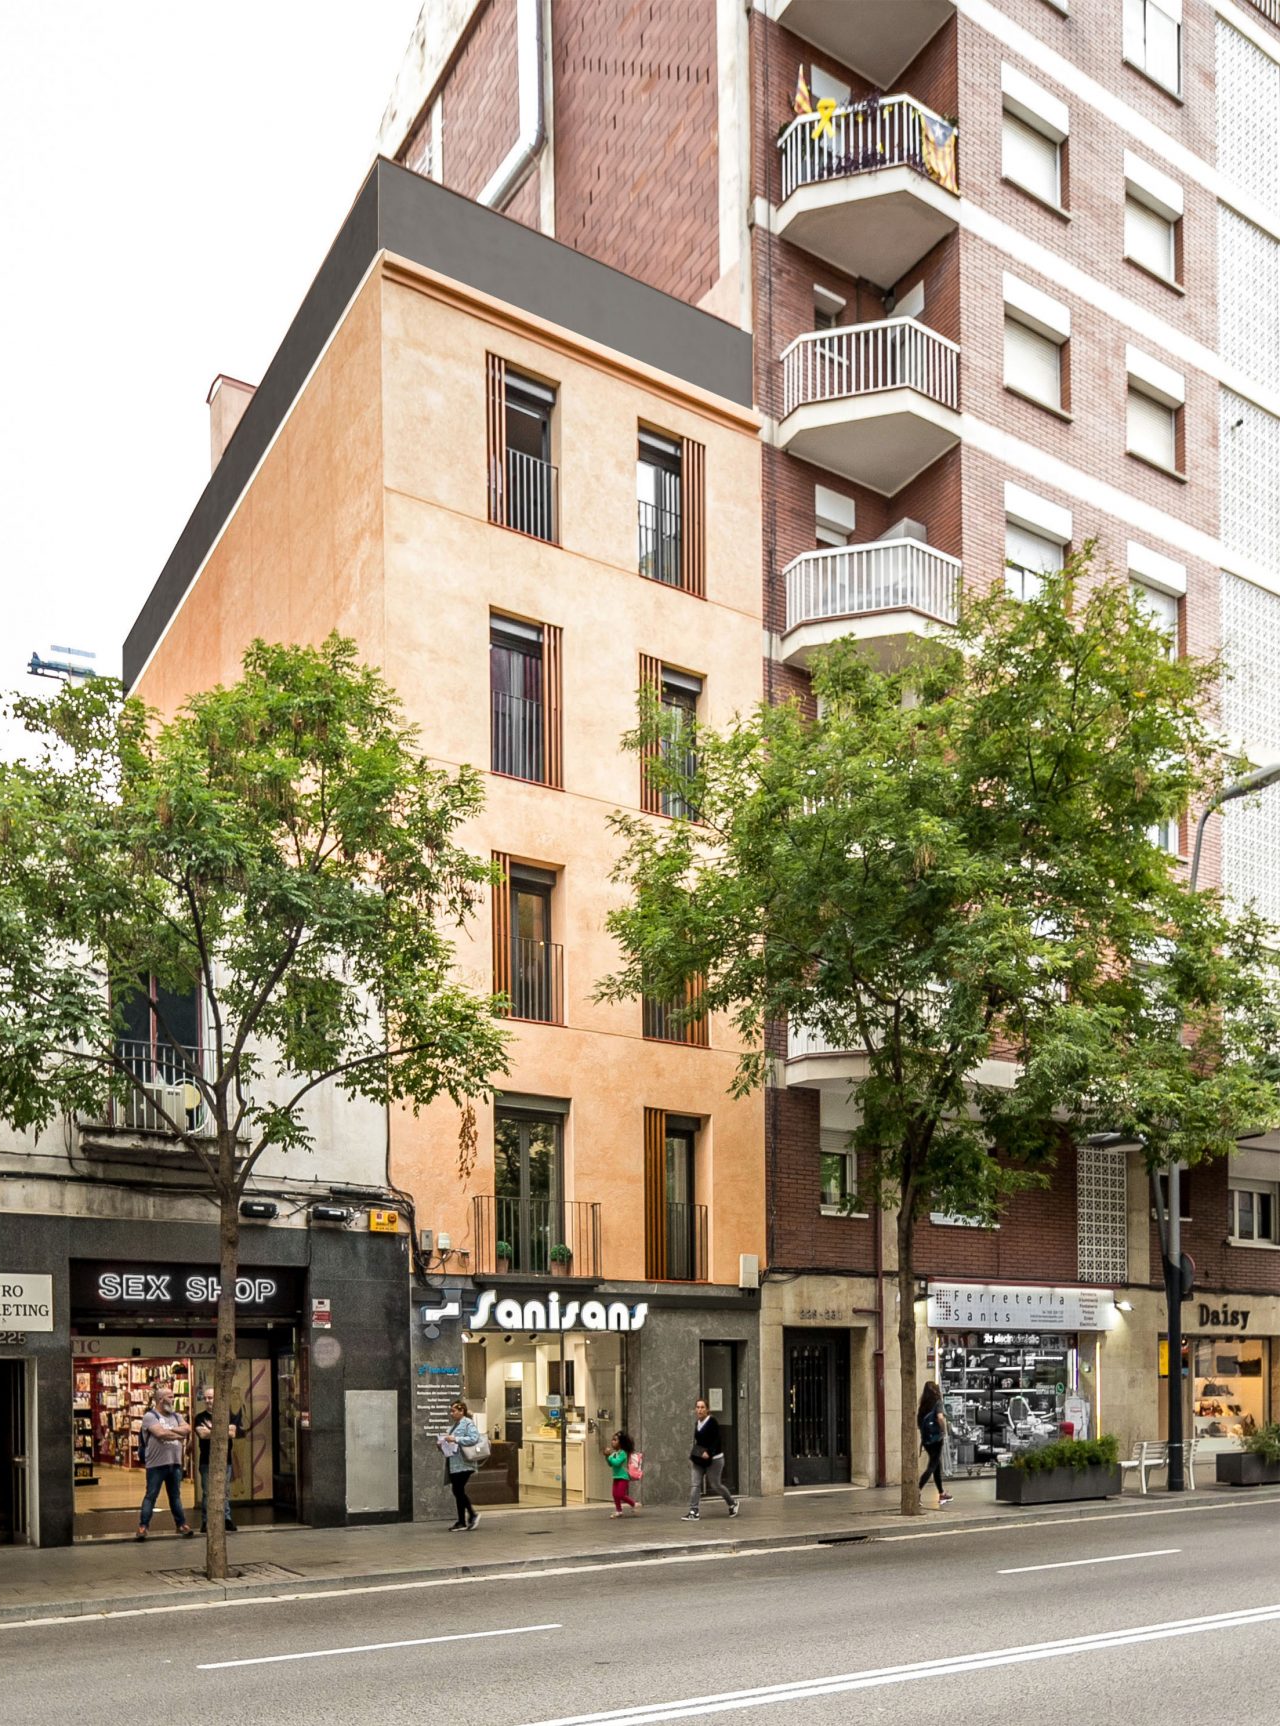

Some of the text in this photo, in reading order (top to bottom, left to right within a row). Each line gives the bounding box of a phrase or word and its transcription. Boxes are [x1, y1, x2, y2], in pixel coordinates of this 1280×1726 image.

[98, 1273, 170, 1300] SEX
[469, 1289, 649, 1331] Sanisans
[953, 1309, 1011, 1323] Sants
[1198, 1303, 1251, 1331] Daisy
